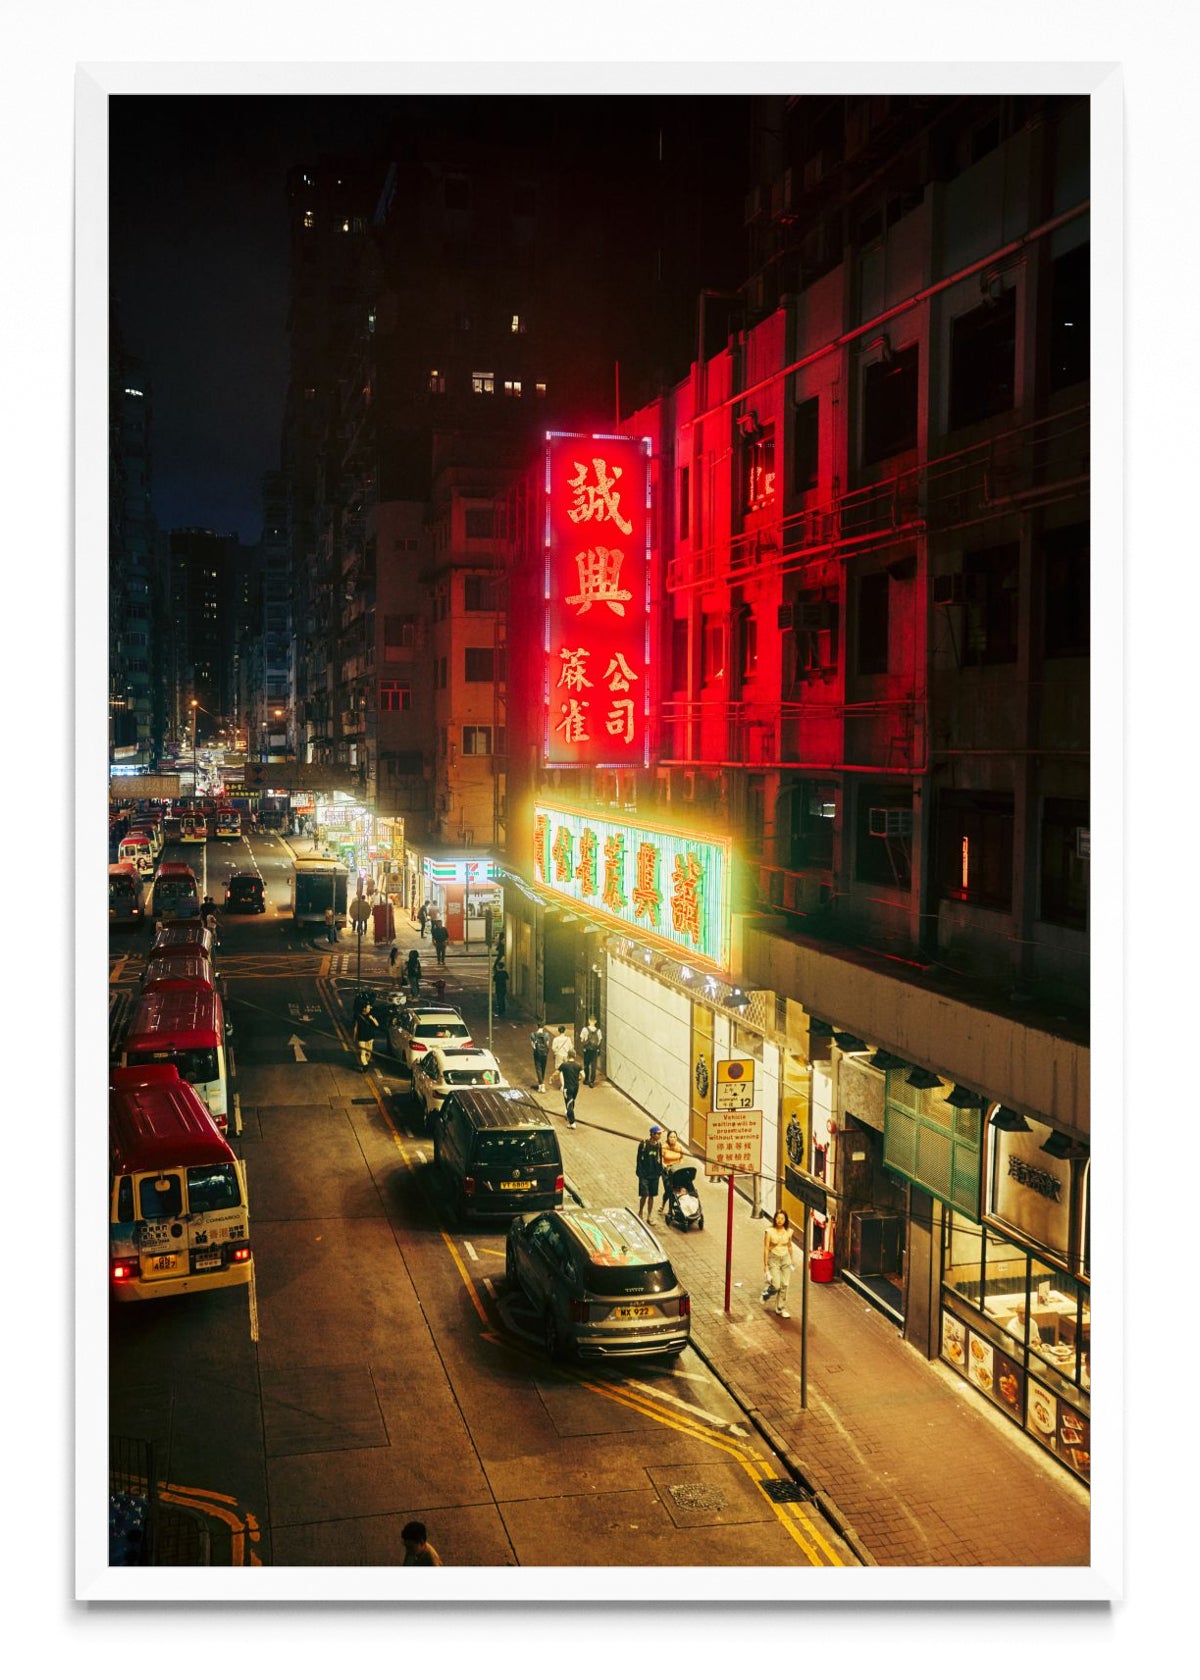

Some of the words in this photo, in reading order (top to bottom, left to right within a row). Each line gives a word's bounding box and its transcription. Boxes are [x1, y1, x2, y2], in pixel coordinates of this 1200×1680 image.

[565, 457, 633, 617] 誠興
[603, 652, 638, 744] 公司
[740, 1083, 746, 1093] 7
[740, 1097, 751, 1107] 12
[621, 1308, 631, 1316] MX
[634, 1307, 649, 1315] 922
